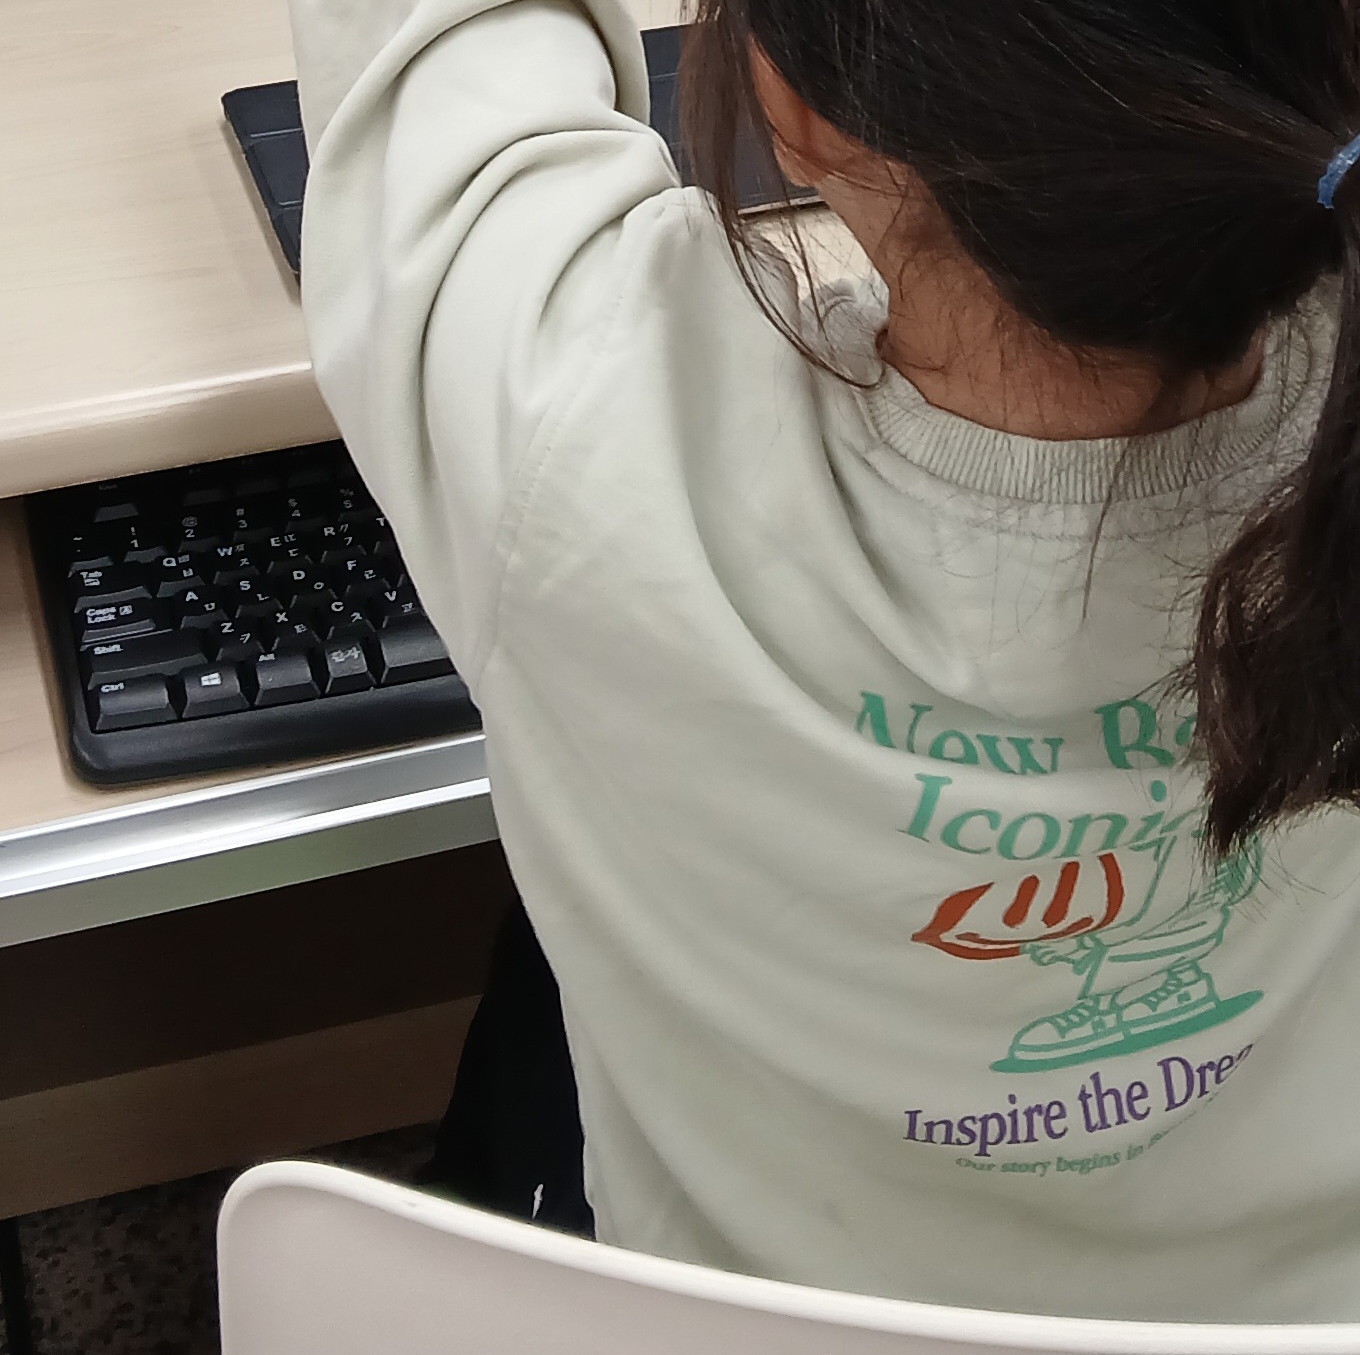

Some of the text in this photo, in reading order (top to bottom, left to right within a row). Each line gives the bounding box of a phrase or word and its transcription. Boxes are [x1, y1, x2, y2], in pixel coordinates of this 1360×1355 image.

[216, 546, 233, 557] W
[162, 557, 177, 567] Q
[346, 559, 357, 571] F
[292, 570, 306, 580] D
[239, 580, 251, 591] S
[185, 590, 199, 602] A
[384, 590, 397, 602] V
[330, 601, 344, 612] C
[275, 611, 289, 623] X
[220, 622, 235, 633] Z
[855, 690, 1065, 775] New
[902, 1093, 1069, 1158] Inspire
[1078, 1071, 1151, 1133] the
[1055, 1152, 1122, 1175] begins
